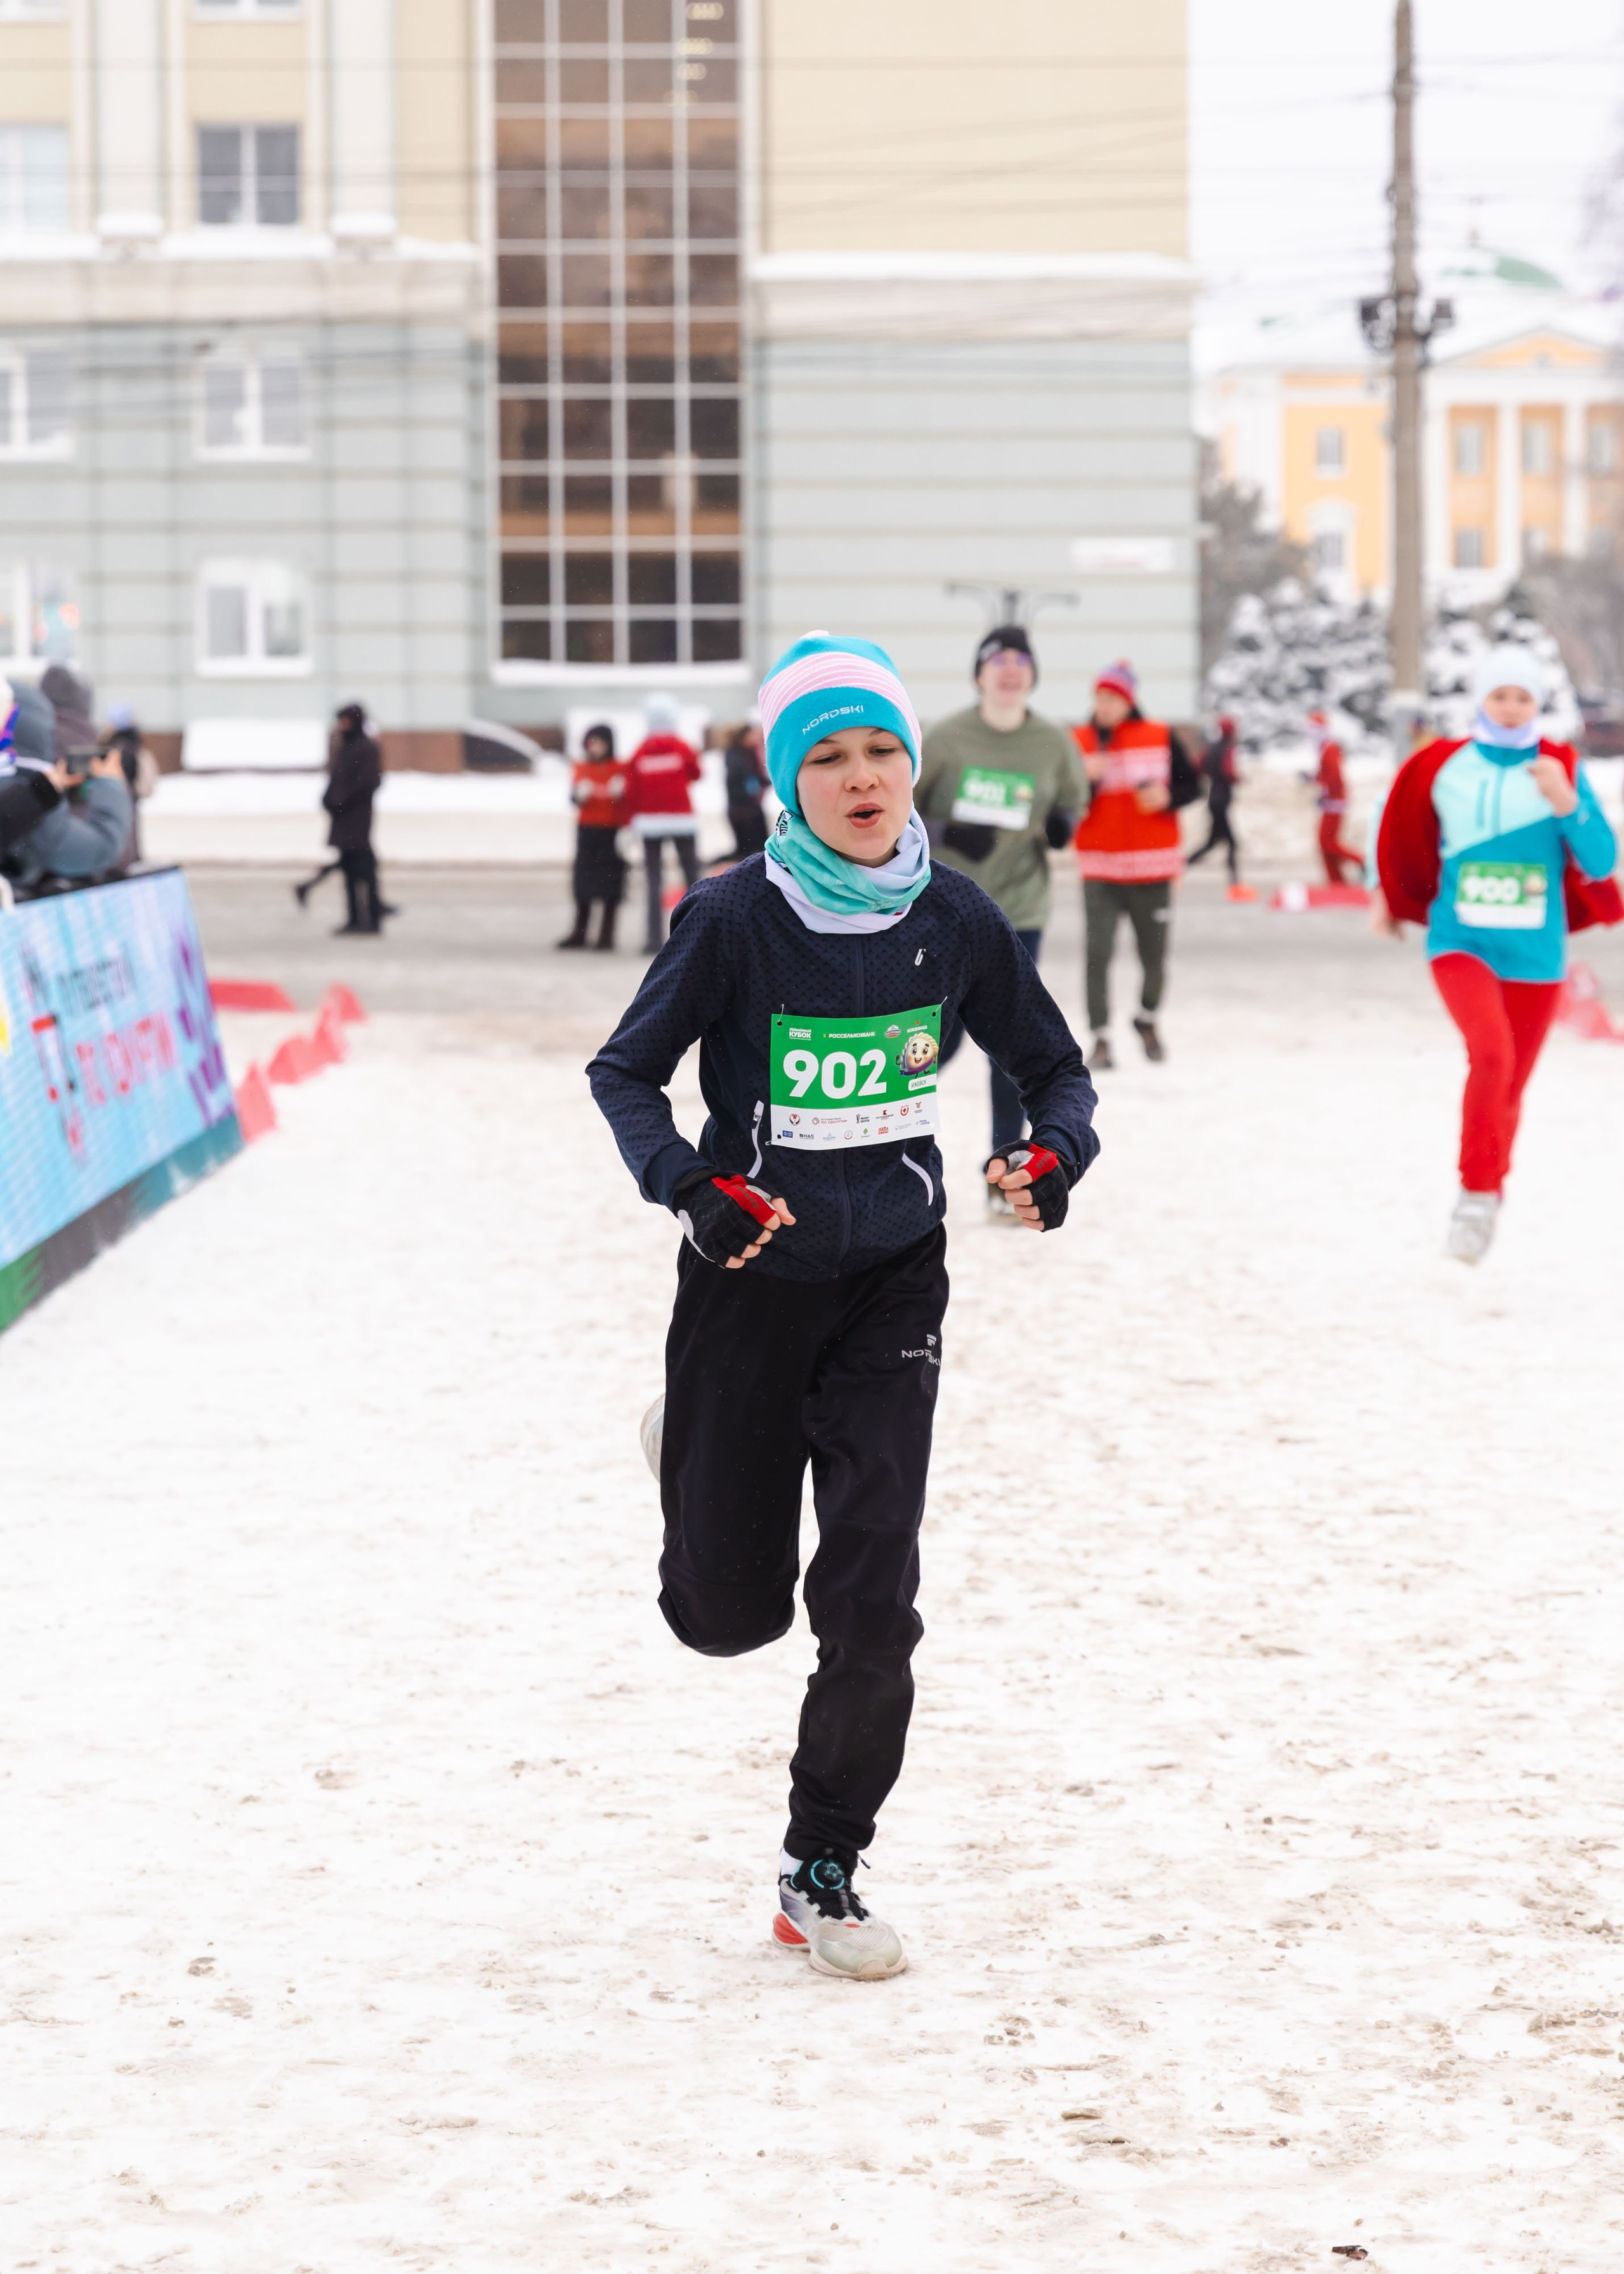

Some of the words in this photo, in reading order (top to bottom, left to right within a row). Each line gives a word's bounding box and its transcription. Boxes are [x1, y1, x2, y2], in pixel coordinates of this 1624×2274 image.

[802, 705, 864, 735] NORDSKI
[783, 1049, 887, 1100] 902
[911, 1079, 927, 1088] ИЖЕВСК
